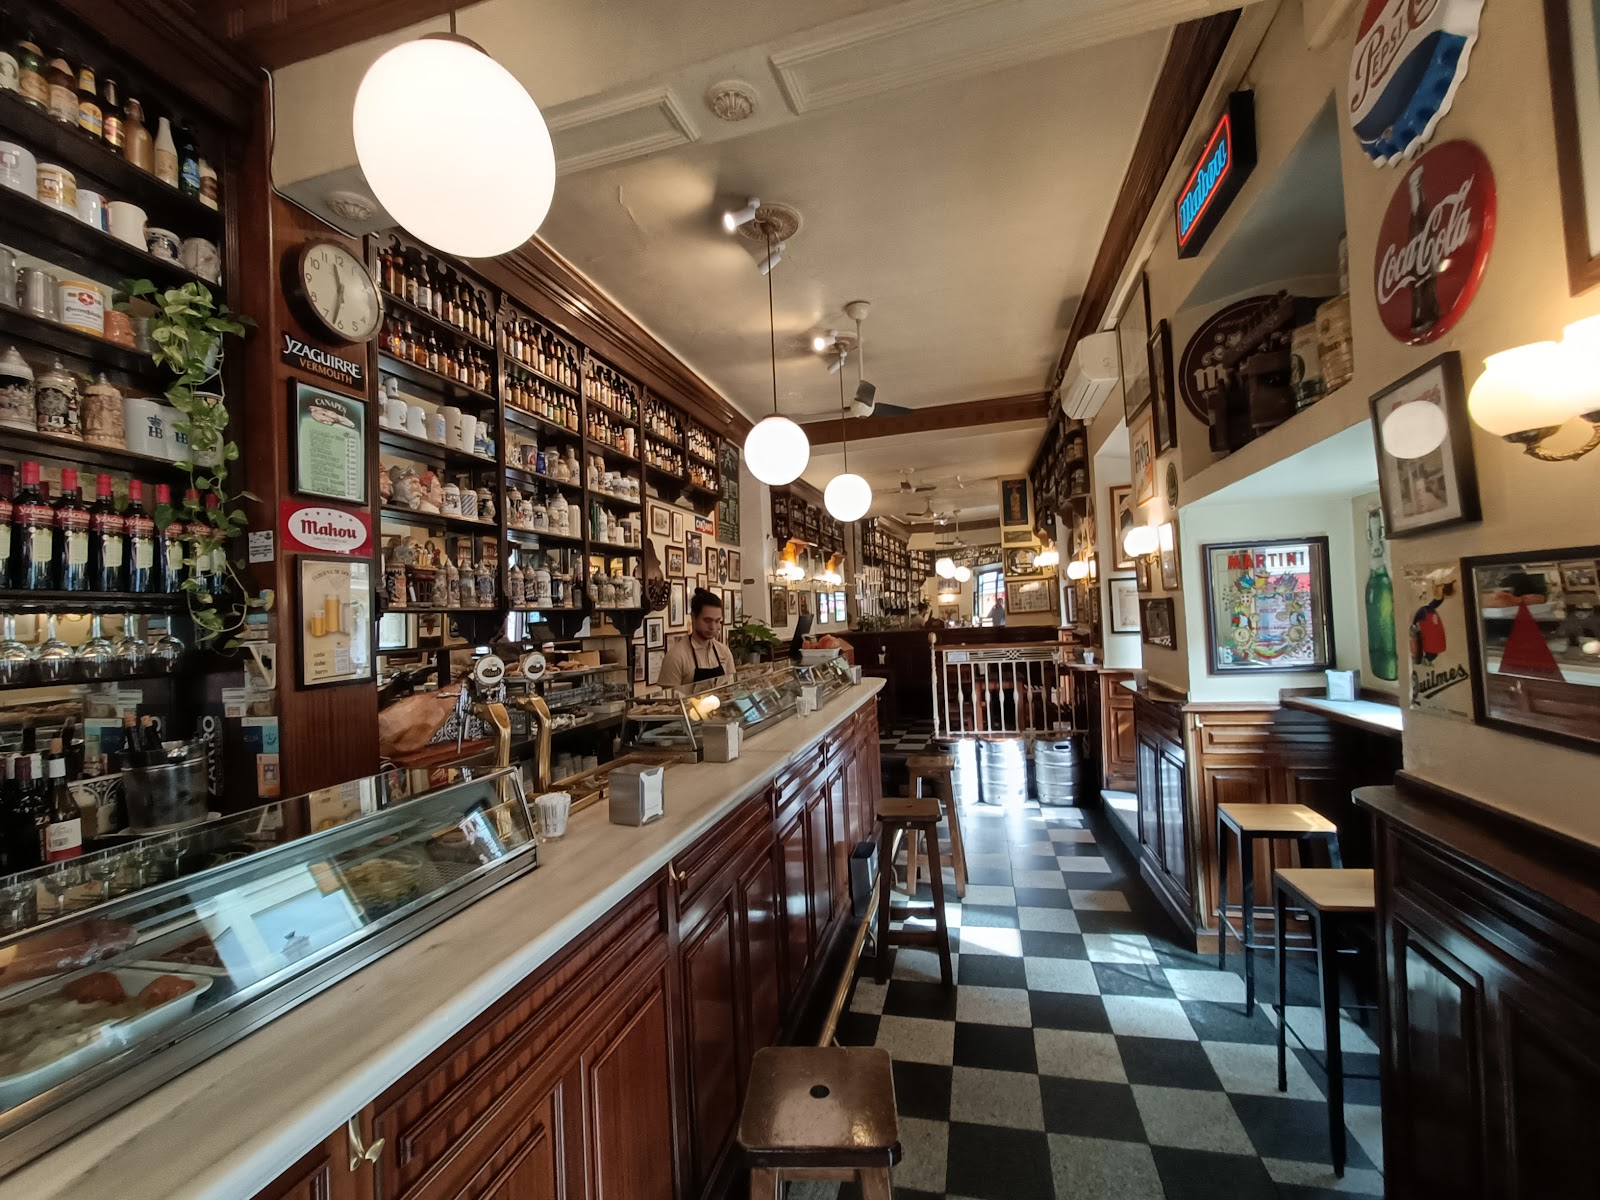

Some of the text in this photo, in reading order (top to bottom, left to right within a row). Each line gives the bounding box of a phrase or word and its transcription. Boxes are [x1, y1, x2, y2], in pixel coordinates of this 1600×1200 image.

[1179, 139, 1227, 237] Mahou
[1378, 173, 1475, 305] Coca-Cola
[310, 257, 320, 270] 10
[321, 251, 328, 263] 11
[335, 253, 344, 268] 12
[305, 273, 313, 283] 9
[310, 291, 318, 303] 8
[322, 307, 330, 318] 7
[337, 321, 344, 330] 6
[352, 321, 359, 332] 5
[283, 334, 362, 379] YZAGUIRRE
[299, 357, 353, 385] VERMOUTH
[148, 425, 163, 439] HB
[175, 431, 189, 445] HB
[300, 519, 357, 539] Mahou
[1228, 551, 1305, 571] MARTINI
[1412, 664, 1469, 706] Quilmes
